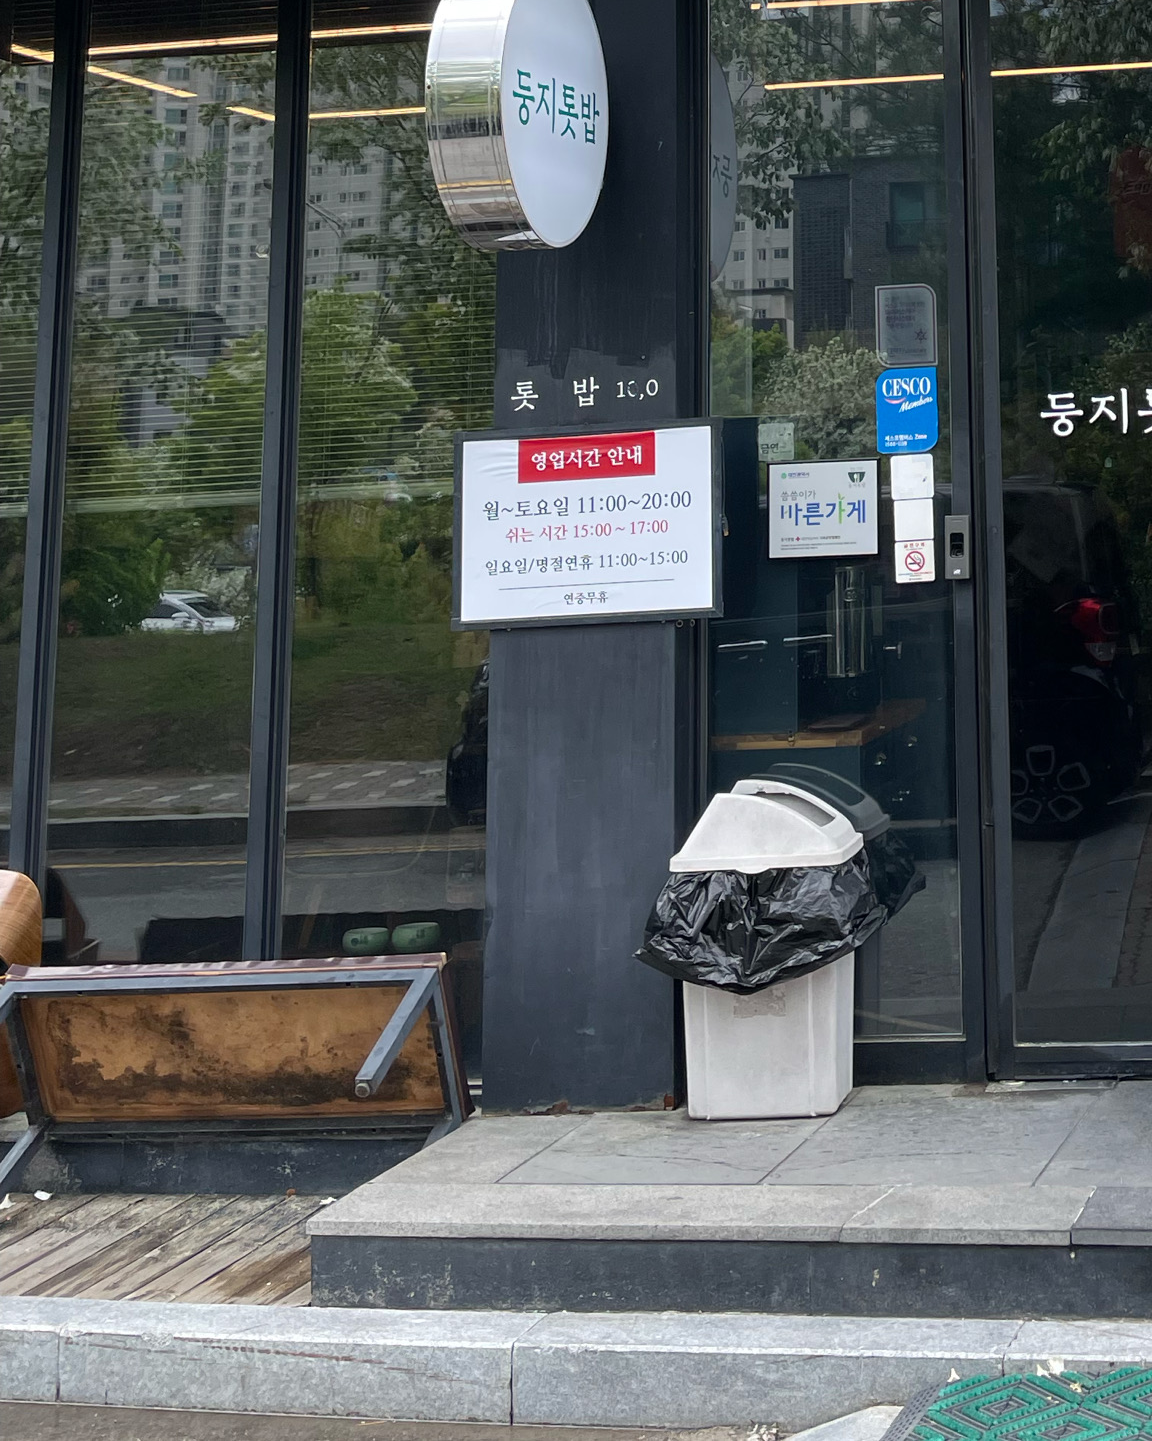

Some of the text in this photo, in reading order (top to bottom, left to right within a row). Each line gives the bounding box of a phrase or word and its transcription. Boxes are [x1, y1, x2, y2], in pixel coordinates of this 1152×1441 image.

[512, 68, 601, 145] 둥지톳밥
[510, 380, 539, 412] 톳
[572, 376, 600, 408] 밥
[881, 376, 931, 397] CESCO
[899, 395, 933, 413] Members
[531, 445, 643, 471] 영업시간 안내
[482, 490, 692, 521] 월~토요일 11:00~20:00
[780, 489, 817, 502] 씀씀이가
[779, 497, 868, 527] 바른가게
[505, 526, 534, 544] 쉬는
[538, 523, 569, 542] 시간
[573, 522, 612, 539] 15:00
[629, 519, 669, 535] 17:00
[485, 549, 689, 576] 일요일/명절연휴 11:00~15:00
[563, 590, 609, 606] 연중무휴
